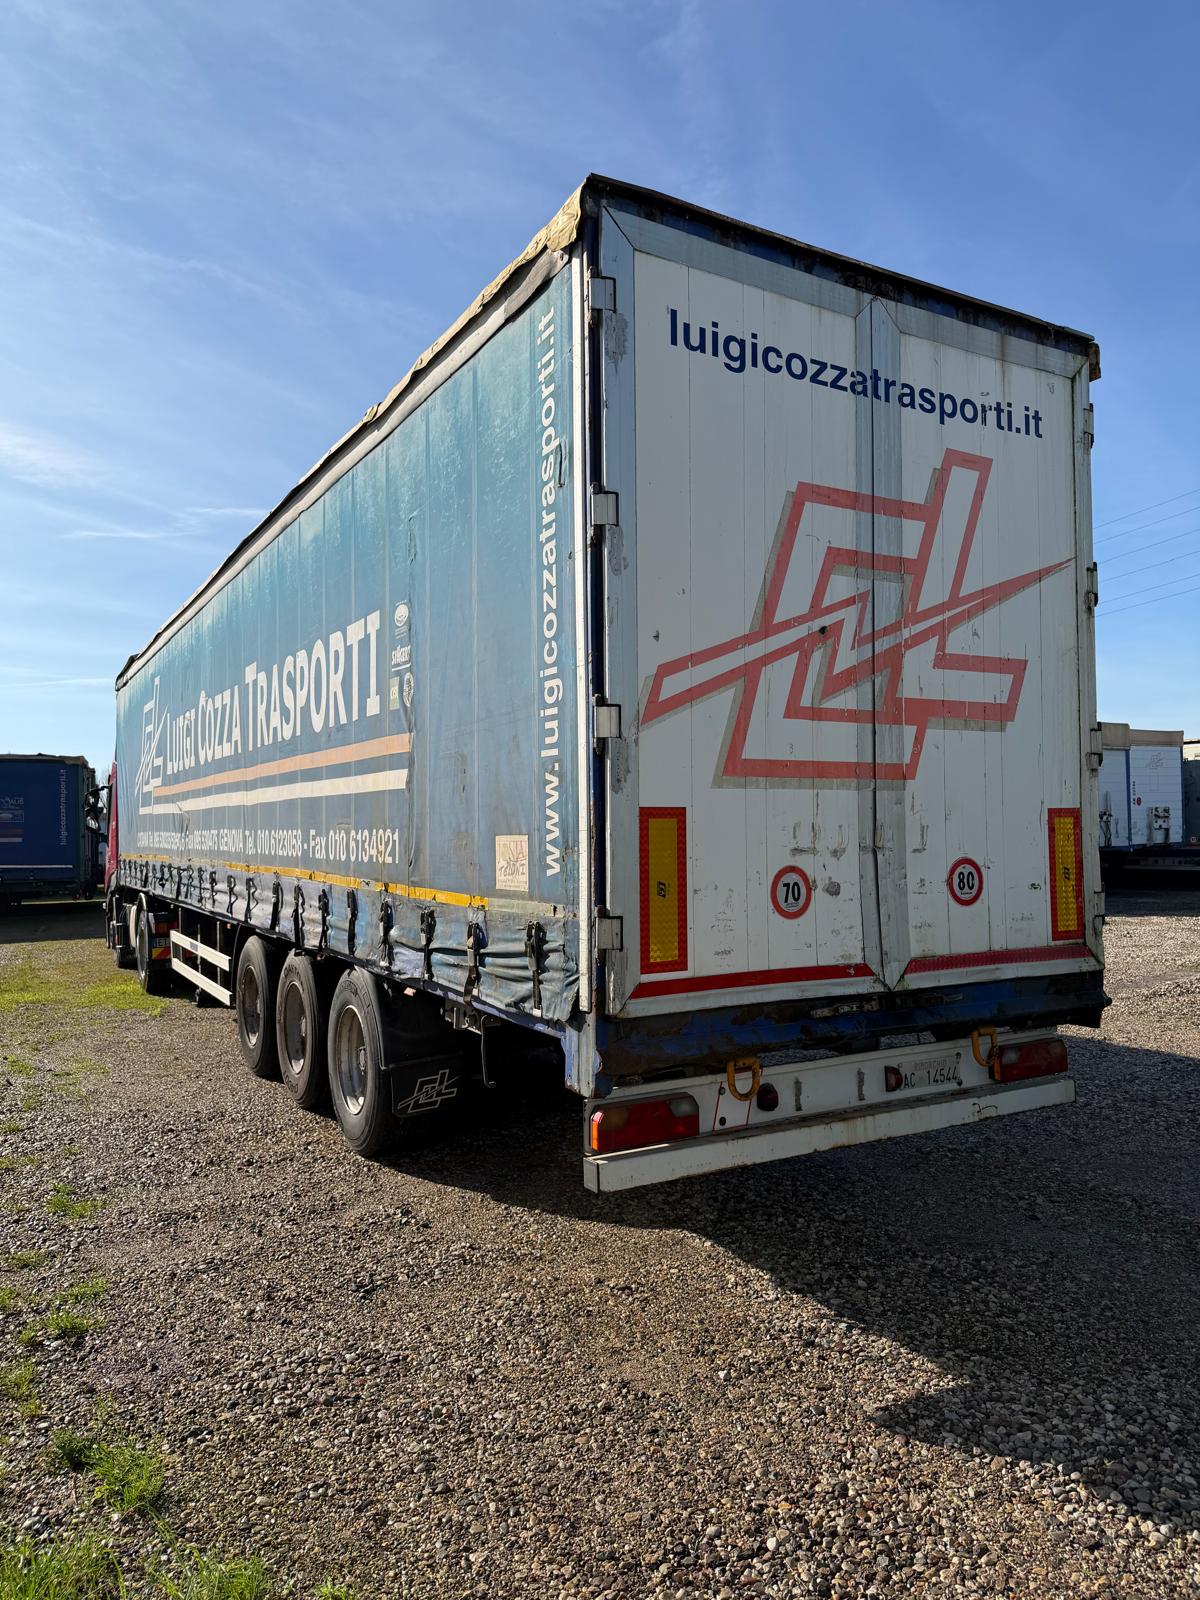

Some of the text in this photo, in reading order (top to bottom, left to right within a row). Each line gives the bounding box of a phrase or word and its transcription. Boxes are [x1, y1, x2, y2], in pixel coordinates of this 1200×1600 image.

[669, 308, 1043, 439] luigicozzatrasporti.it
[537, 306, 564, 877] www.luigicozzatrasporti.it
[166, 609, 381, 775] LUIGI COZZA TRASPORTI
[219, 828, 244, 852] GENOVA
[244, 830, 256, 855] Tel.
[257, 828, 269, 856] 010
[270, 828, 302, 857] 6123058
[309, 828, 326, 860] Fax
[350, 828, 399, 864] 6134921
[782, 881, 801, 903] 70
[958, 871, 975, 891] 80
[904, 1065, 958, 1089] AC 14544
